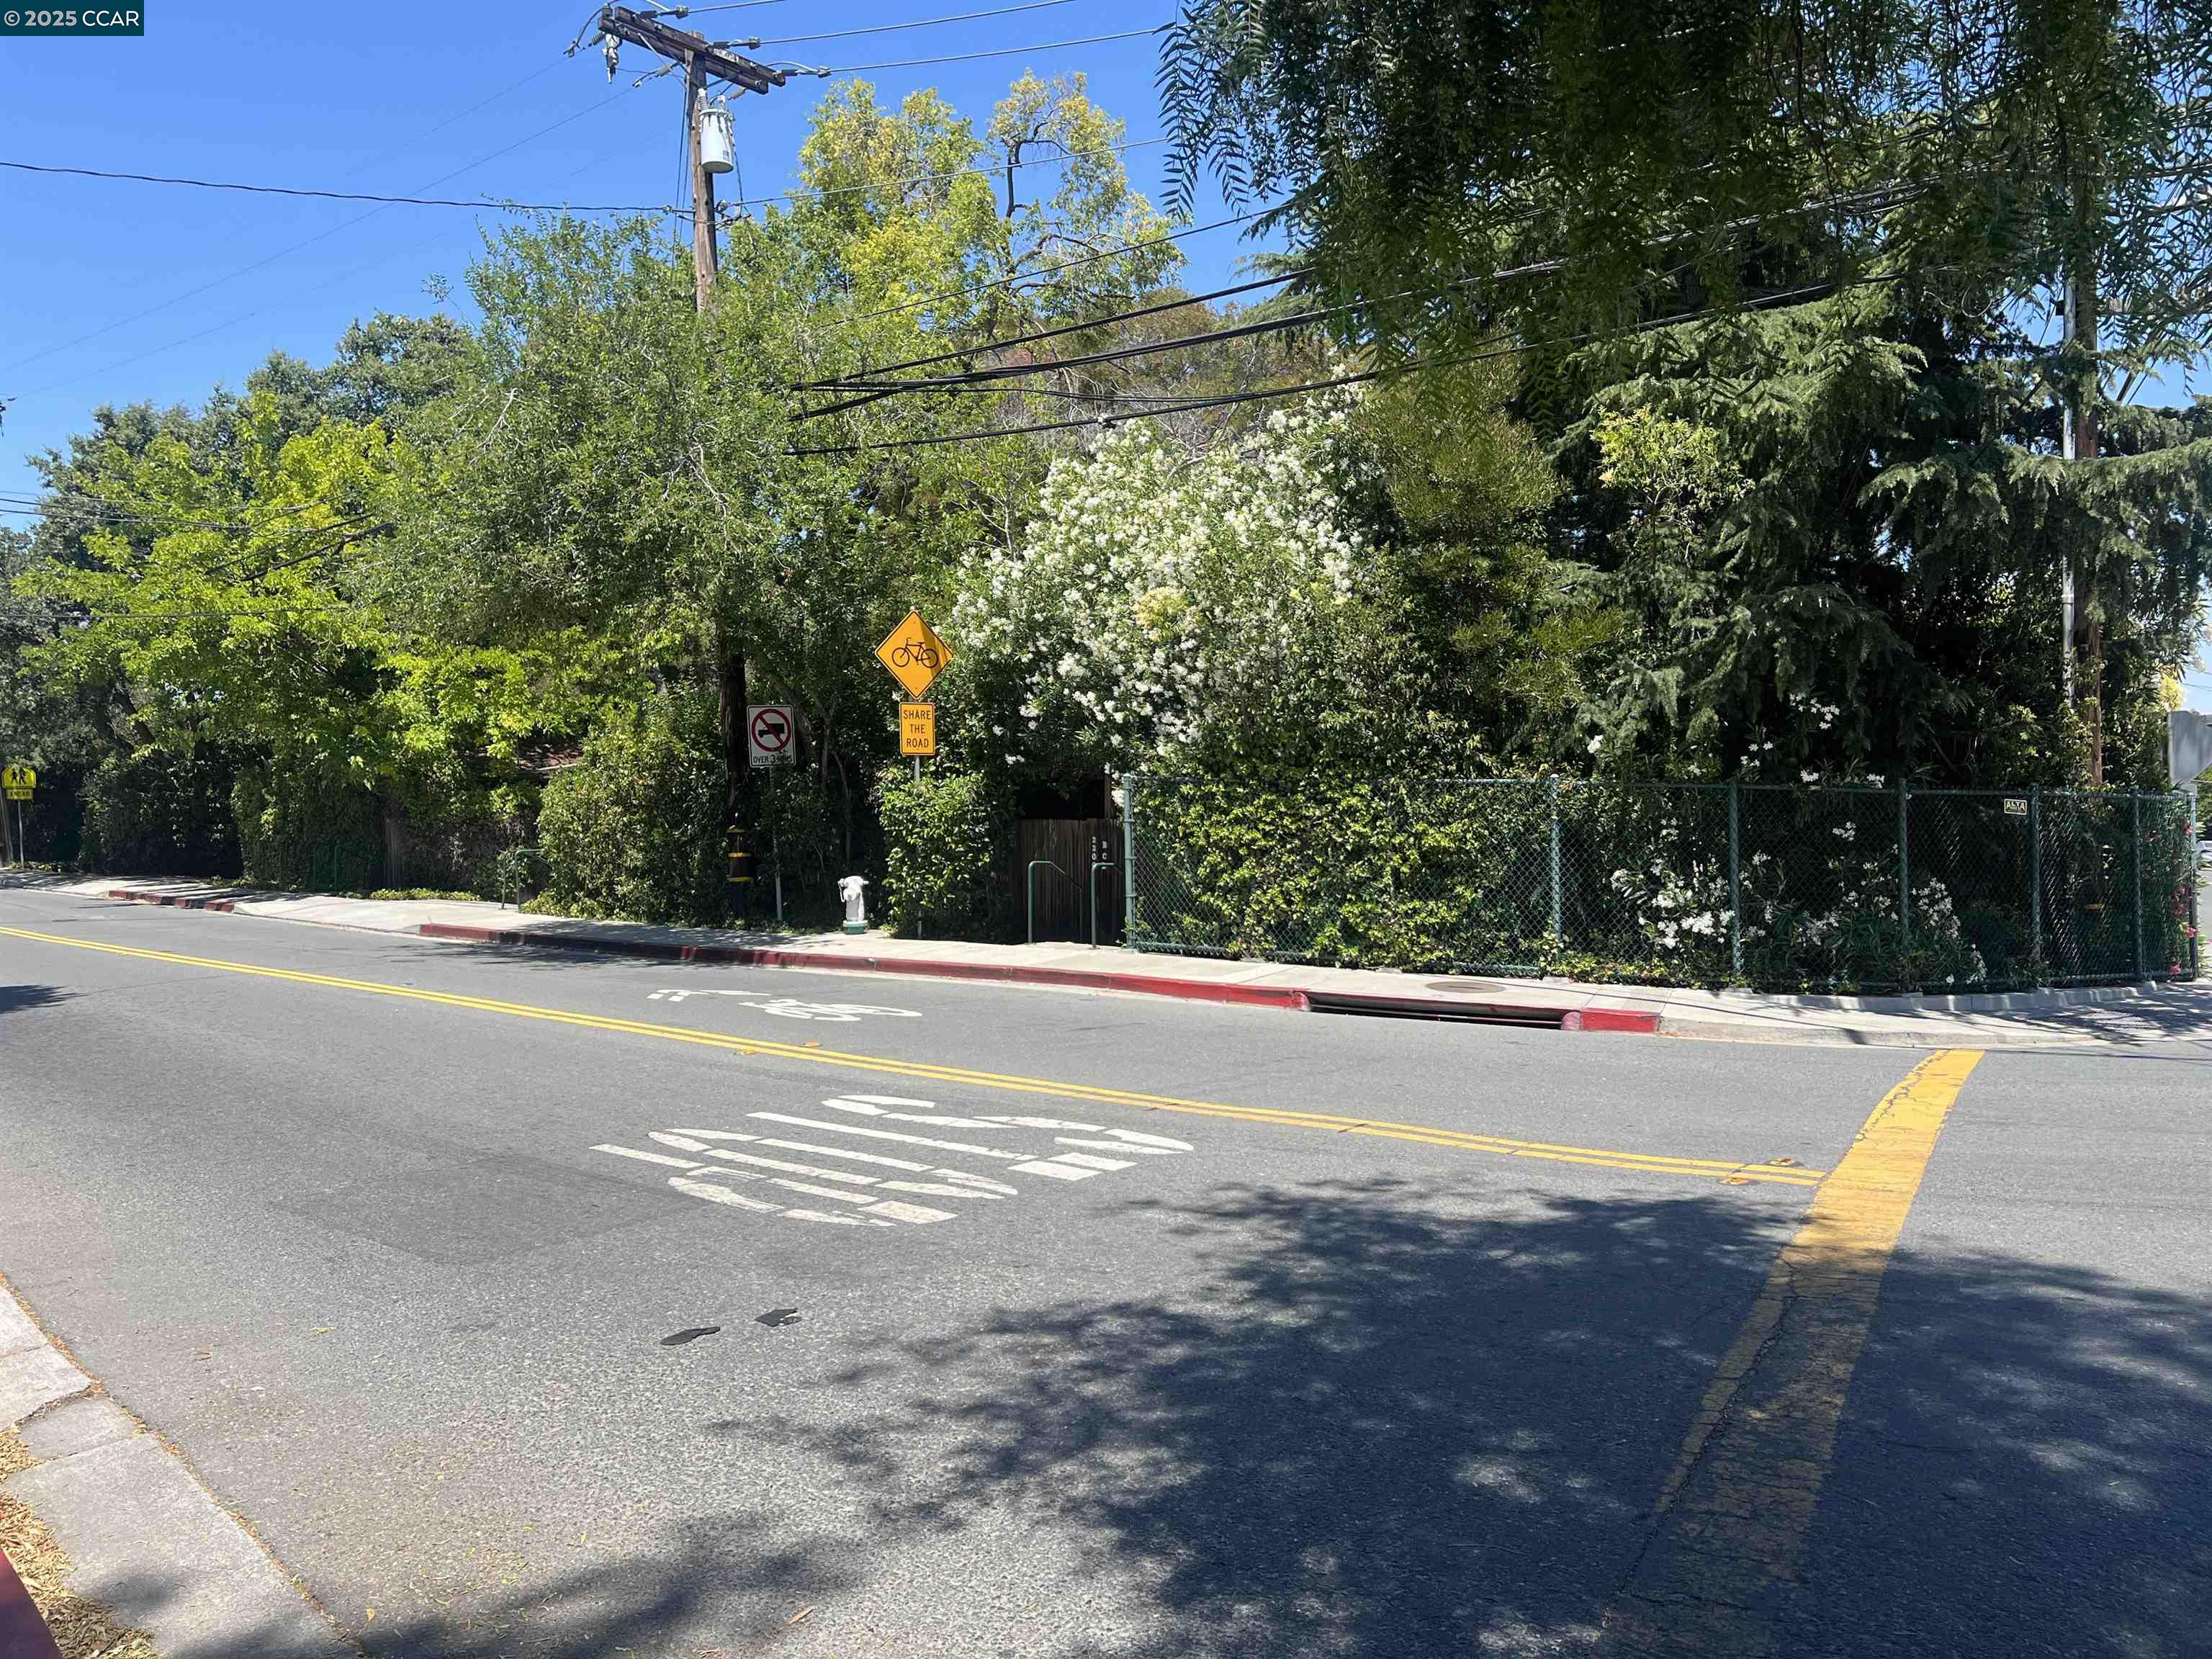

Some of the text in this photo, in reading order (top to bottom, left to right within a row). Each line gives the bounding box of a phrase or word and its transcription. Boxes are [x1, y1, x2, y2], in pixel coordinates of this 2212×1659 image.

[903, 710, 931, 719] SHARE
[910, 724, 925, 734] THE
[907, 739, 929, 748] ROAD
[770, 755, 775, 763] 3
[2006, 801, 2025, 809] ALTA
[588, 1094, 1195, 1228] STOP
